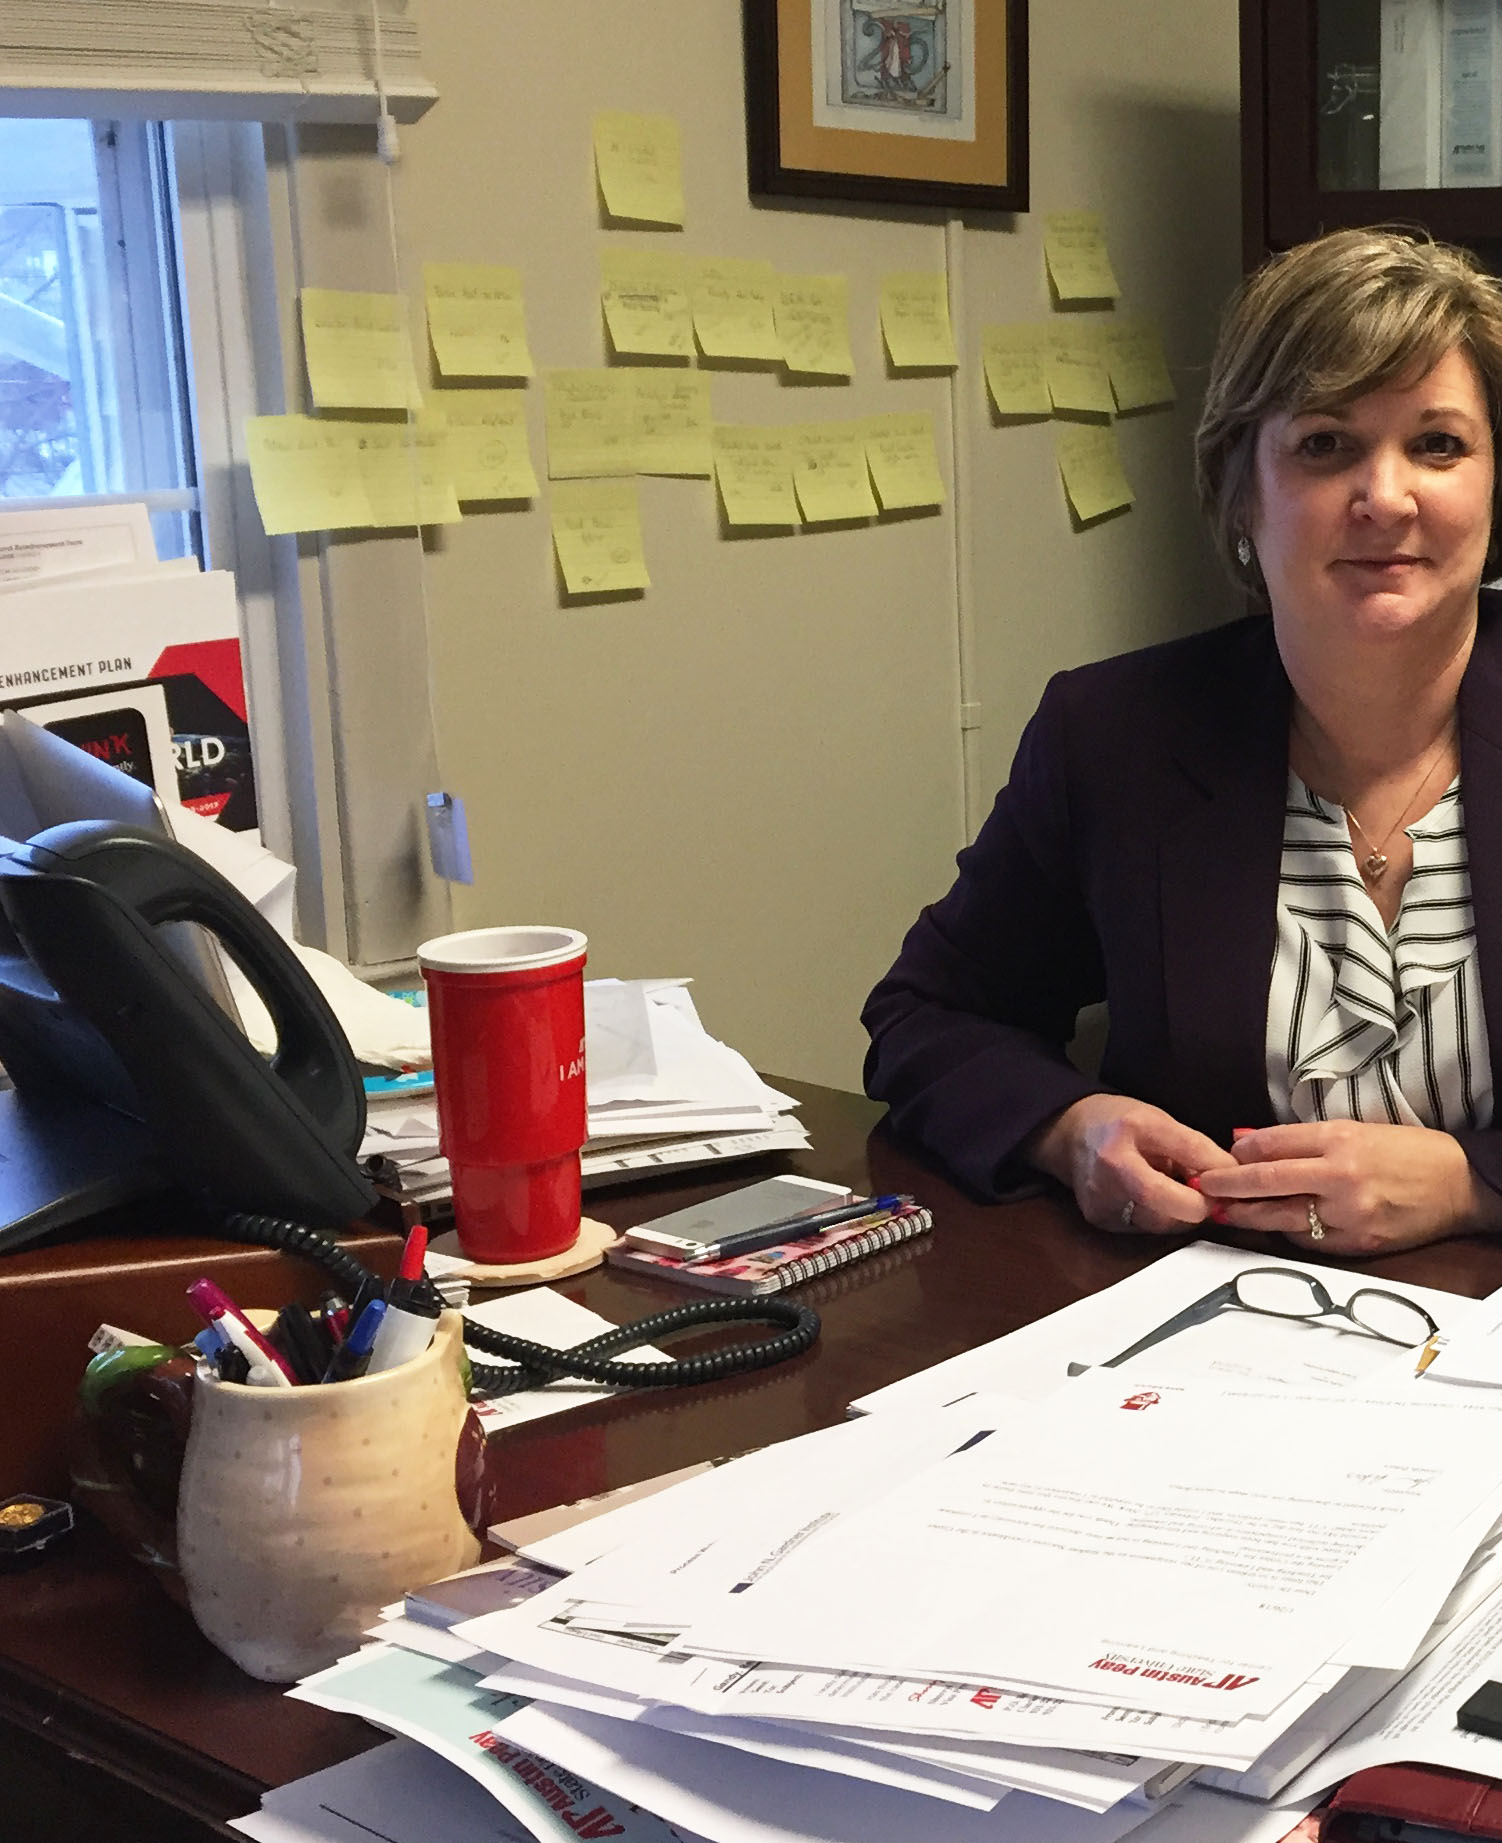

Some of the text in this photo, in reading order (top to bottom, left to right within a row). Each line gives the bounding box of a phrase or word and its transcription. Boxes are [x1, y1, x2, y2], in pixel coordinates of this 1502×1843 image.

[0, 656, 132, 689] ENHANCEMENT PLAN
[559, 1065, 565, 1082] I
[1087, 1659, 1141, 1677] Peay
[1100, 1653, 1215, 1678] State University
[1139, 1667, 1205, 1686] Austin
[467, 1730, 521, 1764] Peay
[511, 1758, 576, 1812] Austin
[552, 1768, 591, 1801] State
